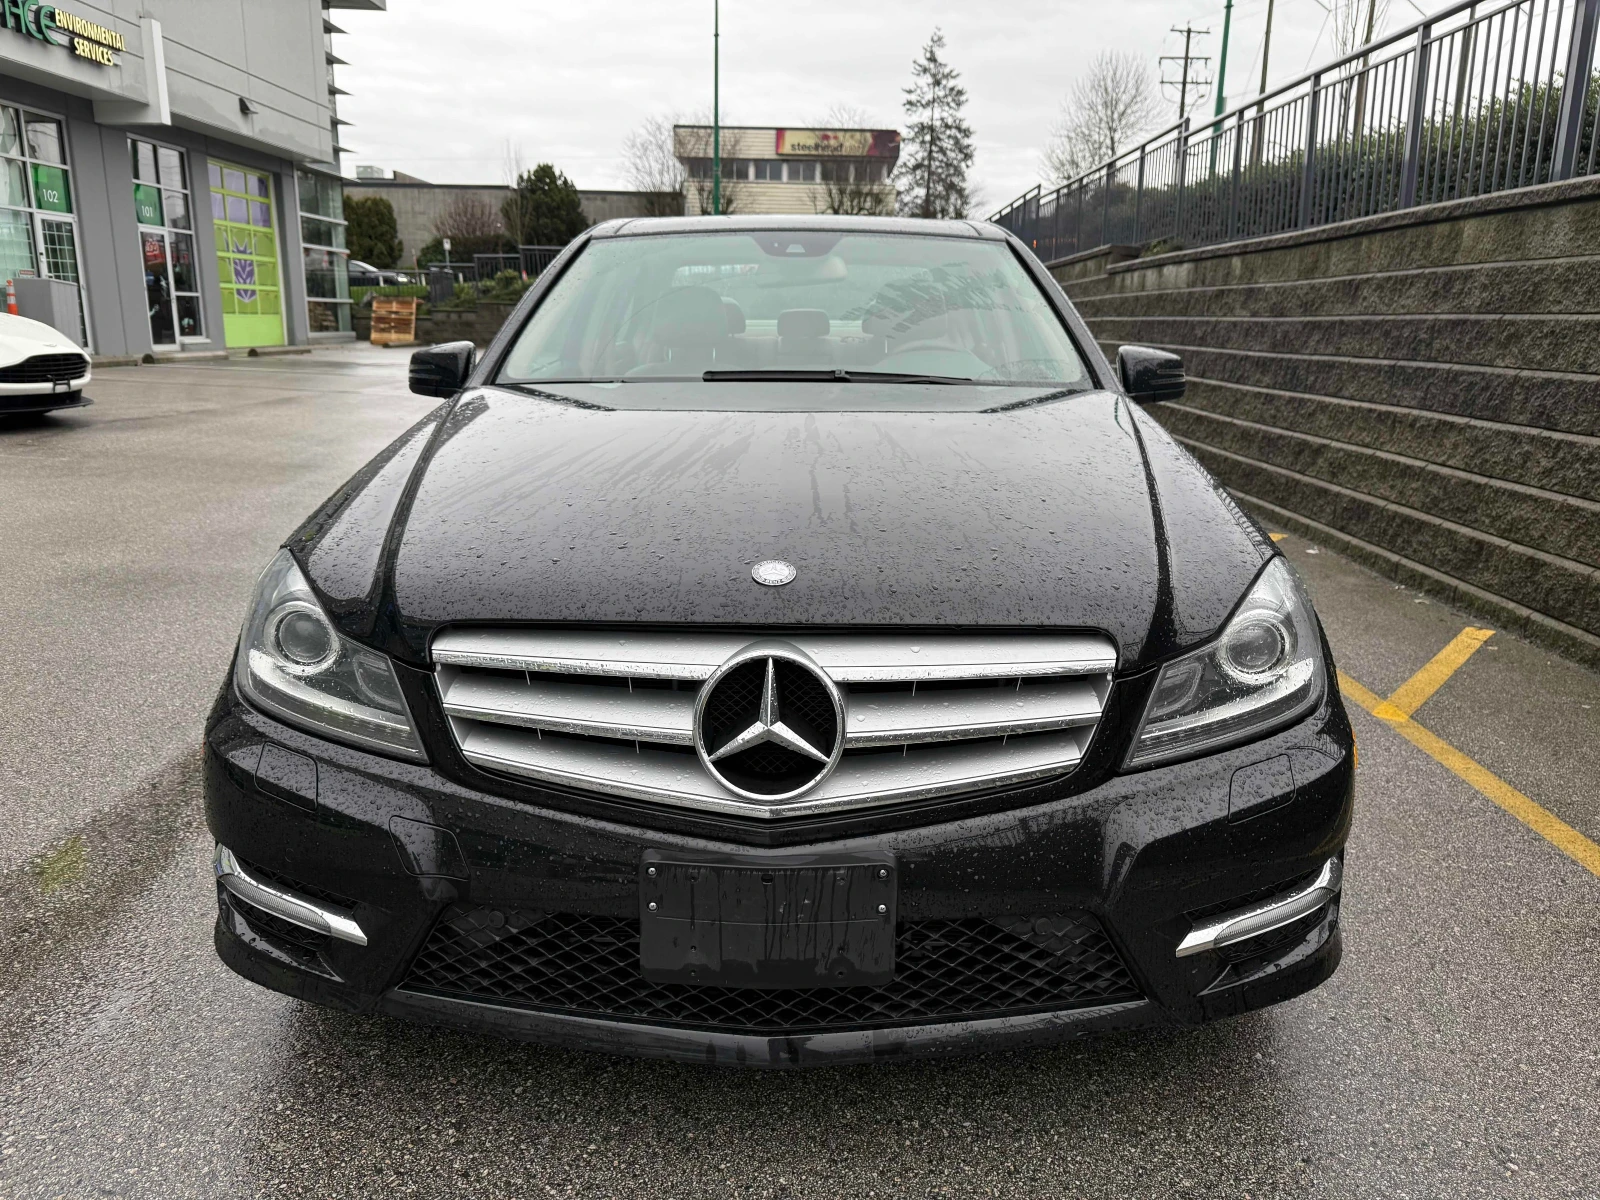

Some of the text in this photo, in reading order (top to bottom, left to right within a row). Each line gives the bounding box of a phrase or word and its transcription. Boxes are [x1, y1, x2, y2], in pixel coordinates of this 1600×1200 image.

[55, 8, 126, 52] ENVIRONMENTAL
[73, 37, 114, 67] SERVICES
[43, 189, 59, 203] 102
[141, 206, 153, 218] 101
